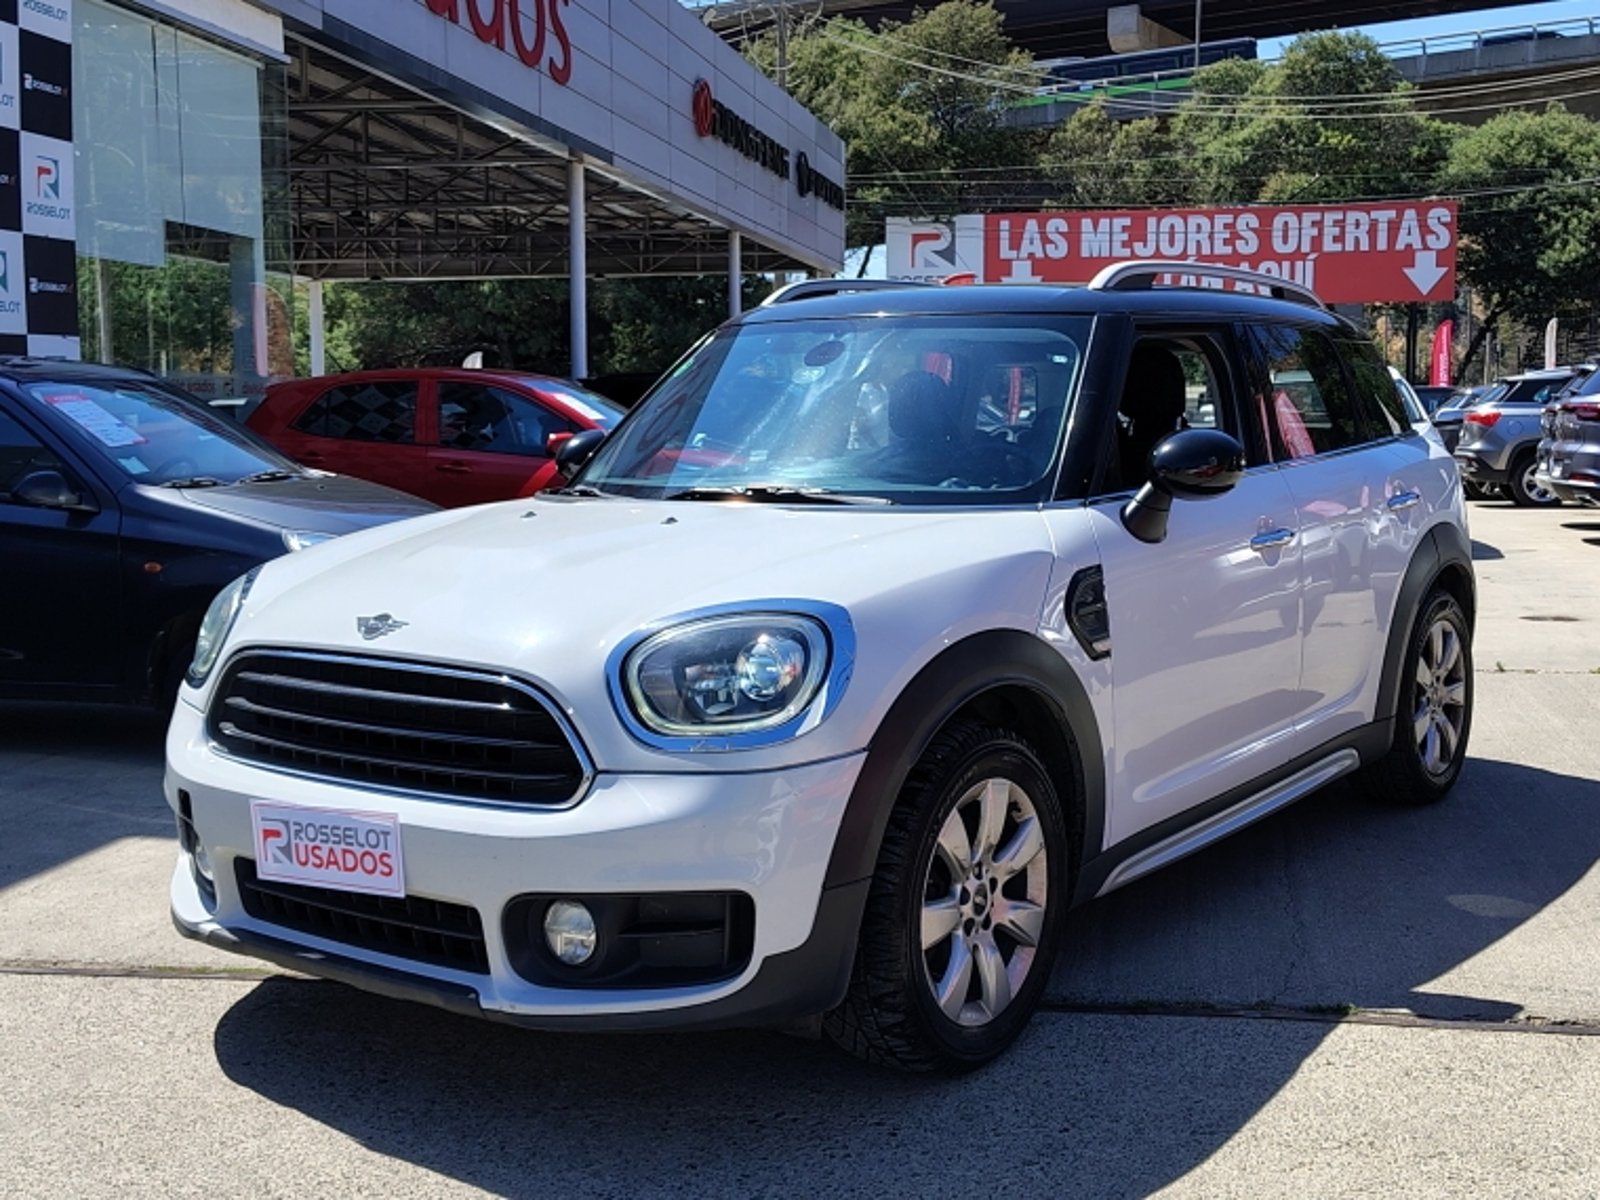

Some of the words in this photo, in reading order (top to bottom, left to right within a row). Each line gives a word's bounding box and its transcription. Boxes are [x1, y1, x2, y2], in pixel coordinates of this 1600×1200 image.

[26, 201, 70, 220] ROSSELOT
[1000, 218, 1069, 260] LAS
[1081, 213, 1260, 258] MEJORES
[1271, 207, 1452, 254] OFERTAS
[293, 821, 391, 851] ROSSELOT
[295, 843, 393, 878] USADOS
